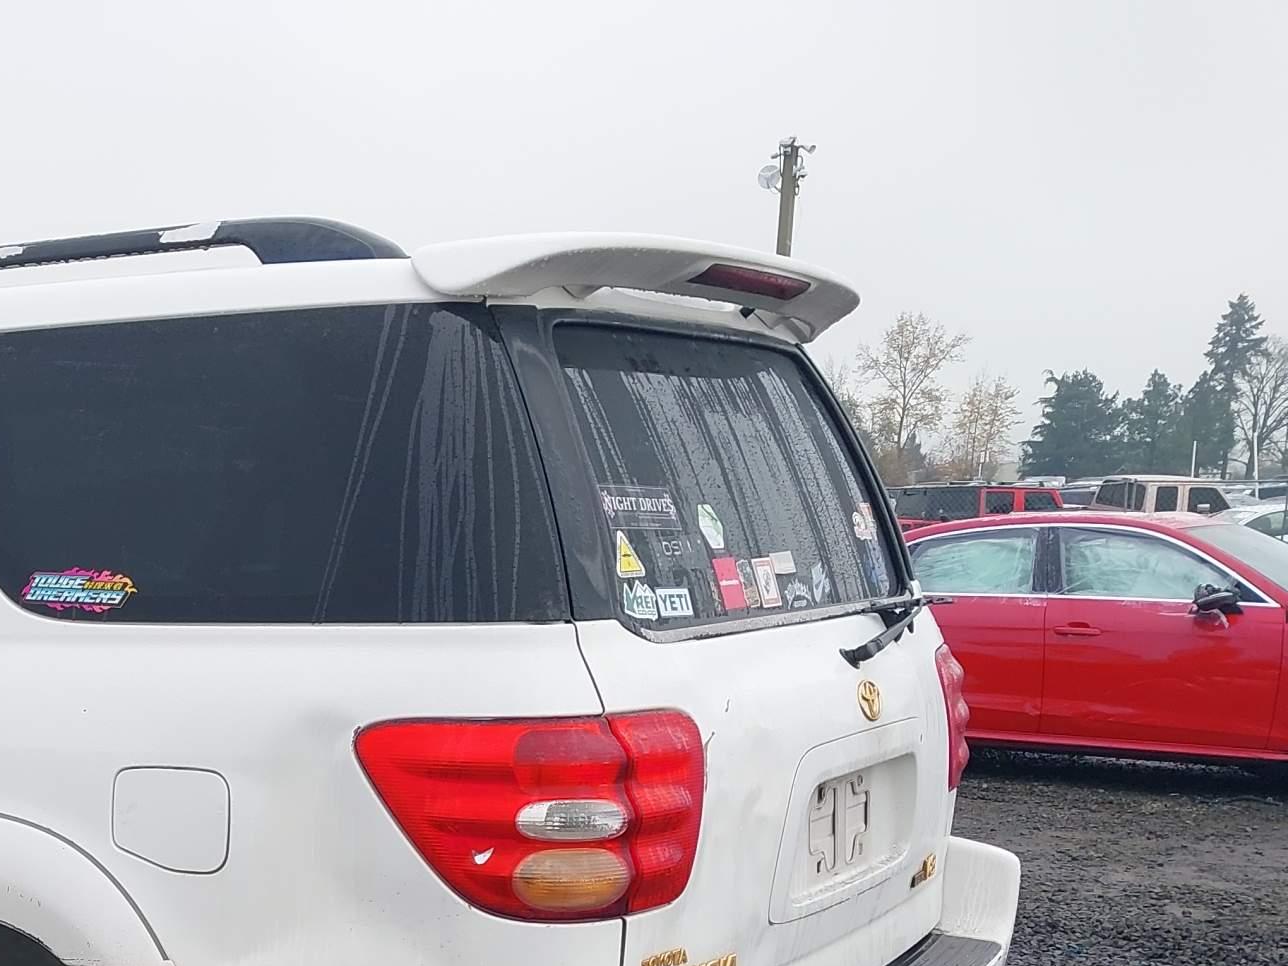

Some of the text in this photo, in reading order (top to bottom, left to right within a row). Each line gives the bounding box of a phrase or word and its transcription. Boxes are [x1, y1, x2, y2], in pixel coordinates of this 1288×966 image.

[601, 494, 676, 513] NIGHT DRIVES
[635, 595, 656, 609] REI
[659, 593, 690, 611] YETI
